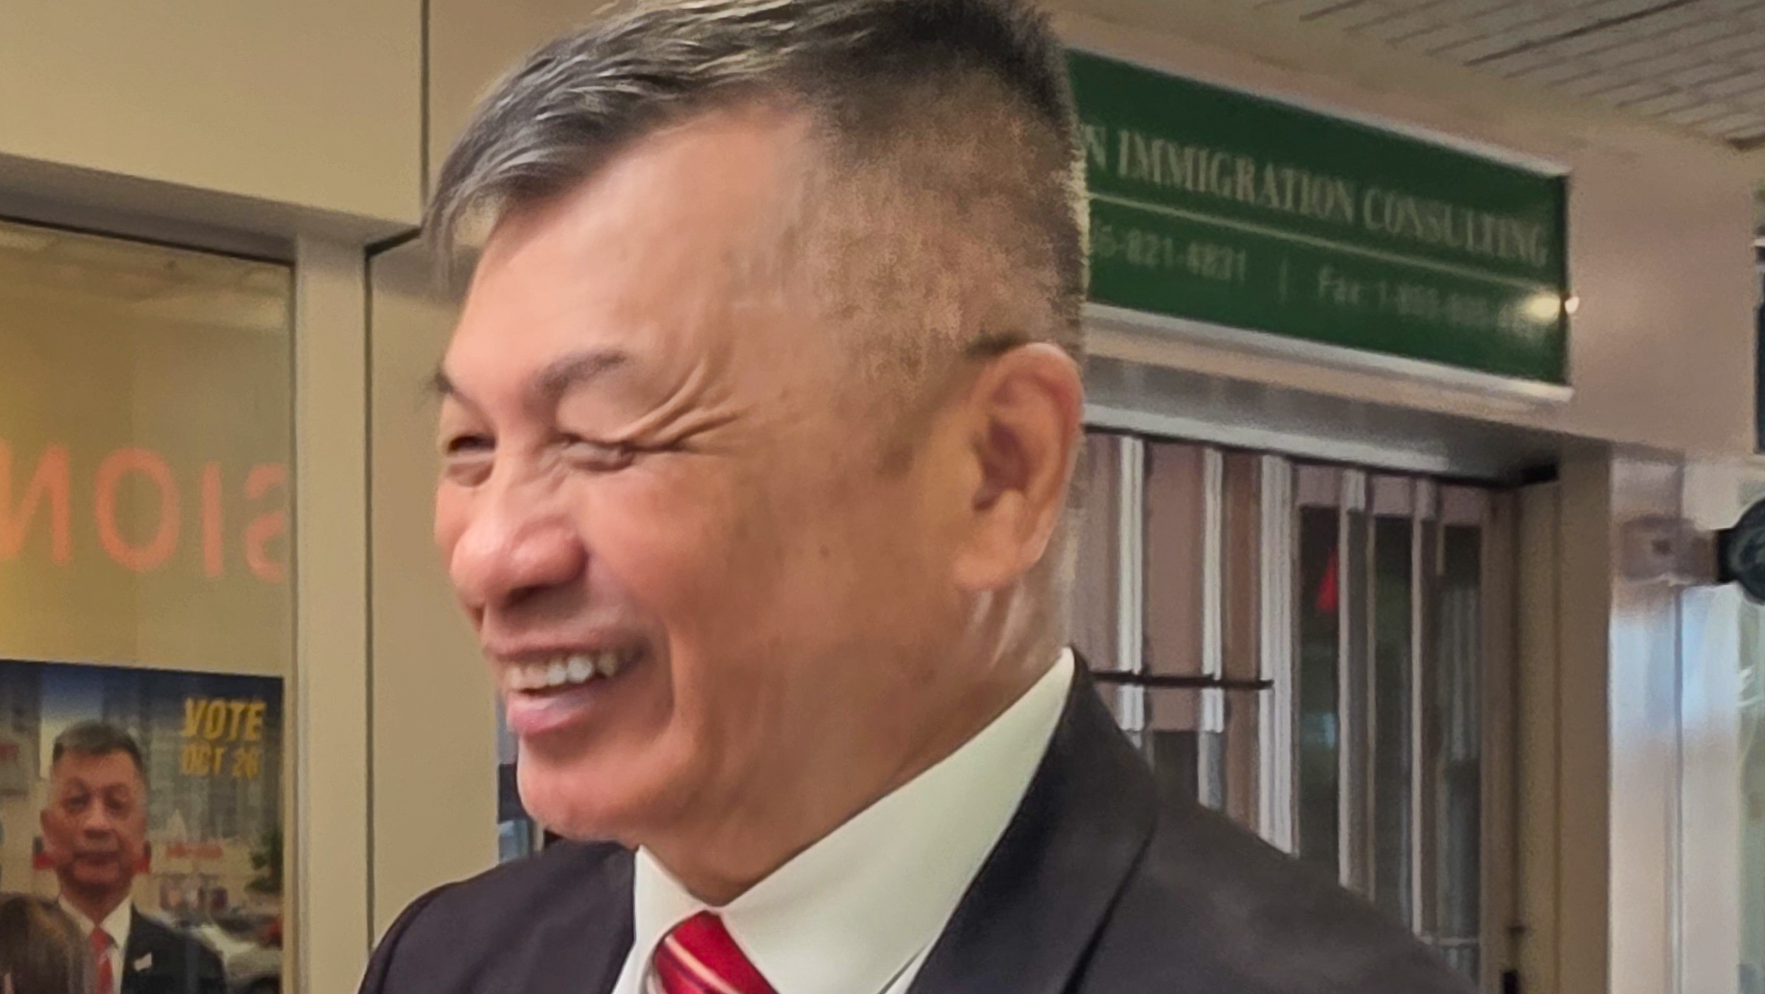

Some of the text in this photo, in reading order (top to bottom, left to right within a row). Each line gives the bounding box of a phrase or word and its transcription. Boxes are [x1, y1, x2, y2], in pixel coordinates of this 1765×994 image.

[1119, 128, 1356, 228] IMMIGRATION
[1363, 186, 1551, 267] CONSULTING
[182, 695, 266, 742] VOTE
[180, 744, 261, 780] OCT 26
